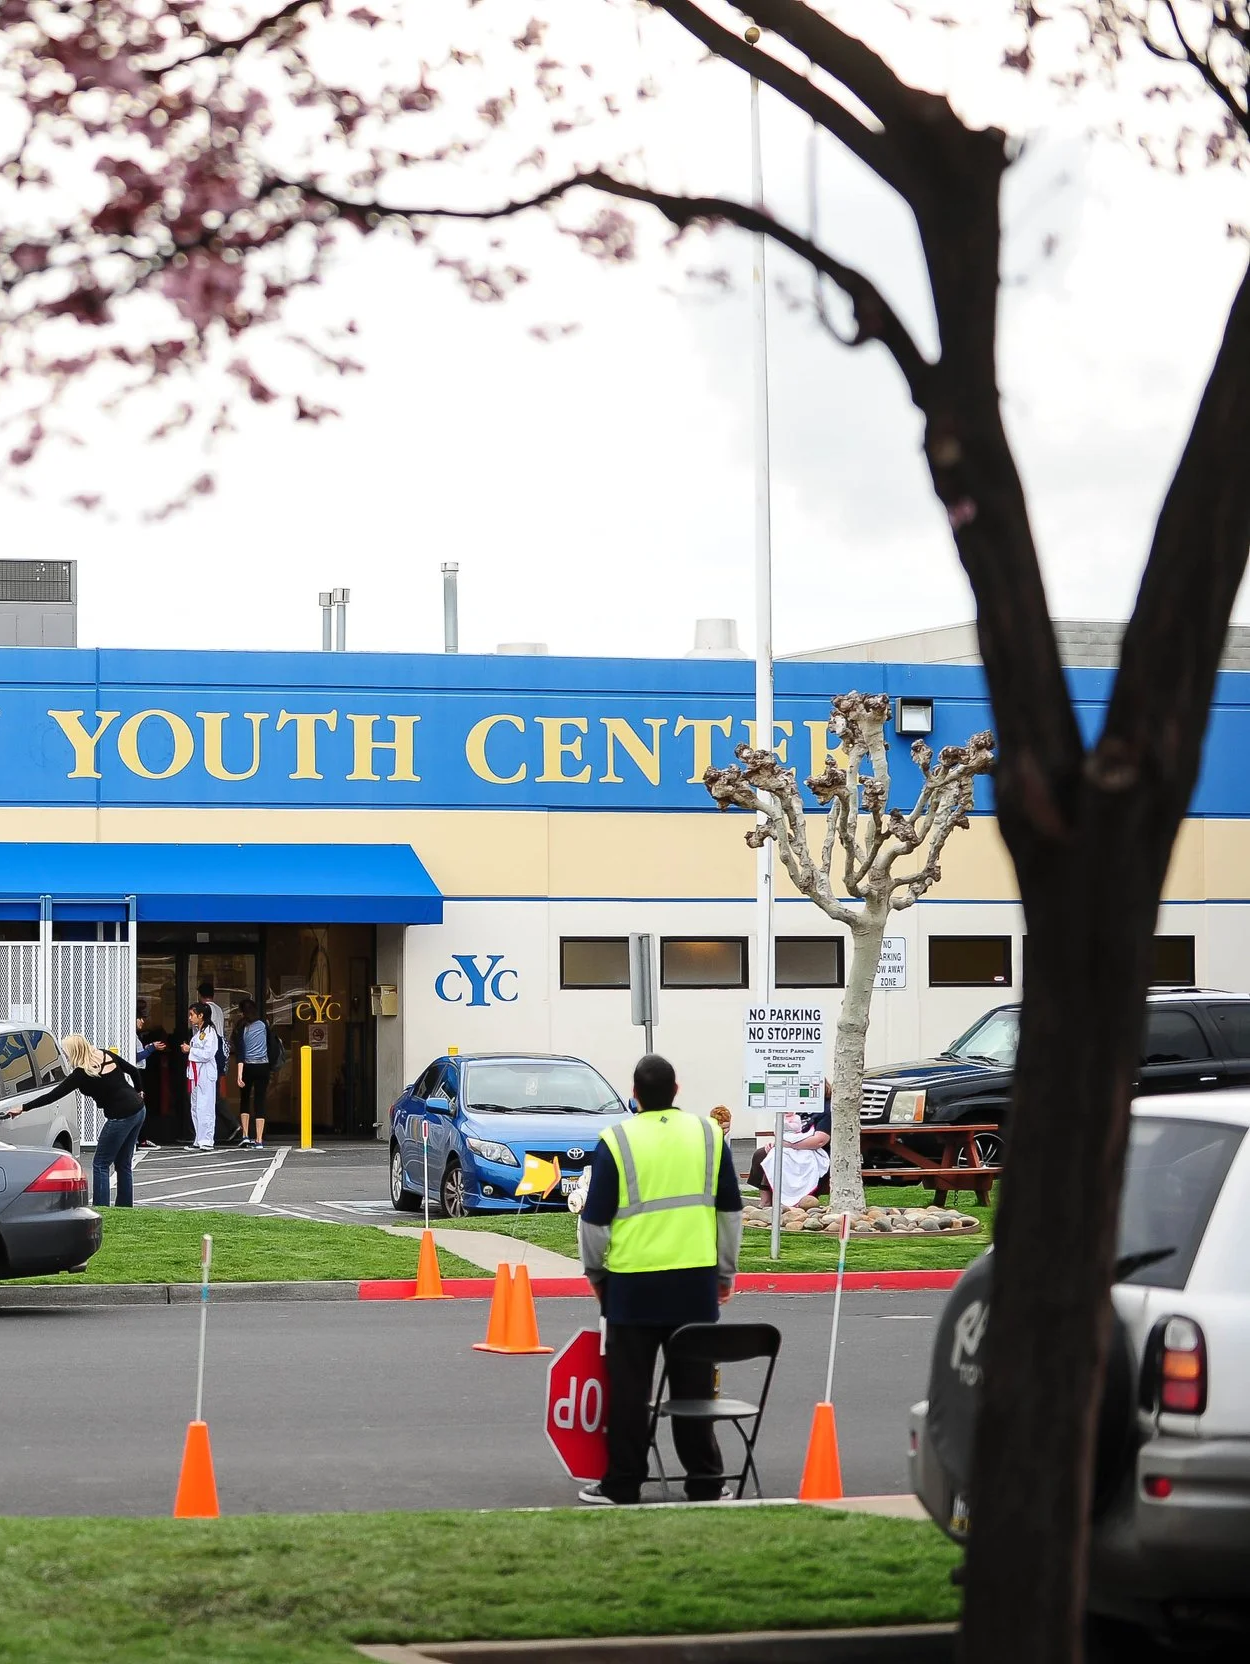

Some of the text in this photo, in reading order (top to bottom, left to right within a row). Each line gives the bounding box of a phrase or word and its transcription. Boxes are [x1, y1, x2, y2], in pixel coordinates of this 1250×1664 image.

[49, 711, 419, 781] YOUTH
[882, 940, 892, 949] NO
[879, 952, 901, 961] ARKING
[876, 965, 904, 974] OW AWAY
[434, 954, 519, 1007] CYC
[880, 977, 897, 986] ZONE
[295, 994, 342, 1024] CYC
[749, 1008, 821, 1021] NO PARKING
[749, 1027, 821, 1041] NO STOPPING
[553, 1375, 608, 1433] OP
